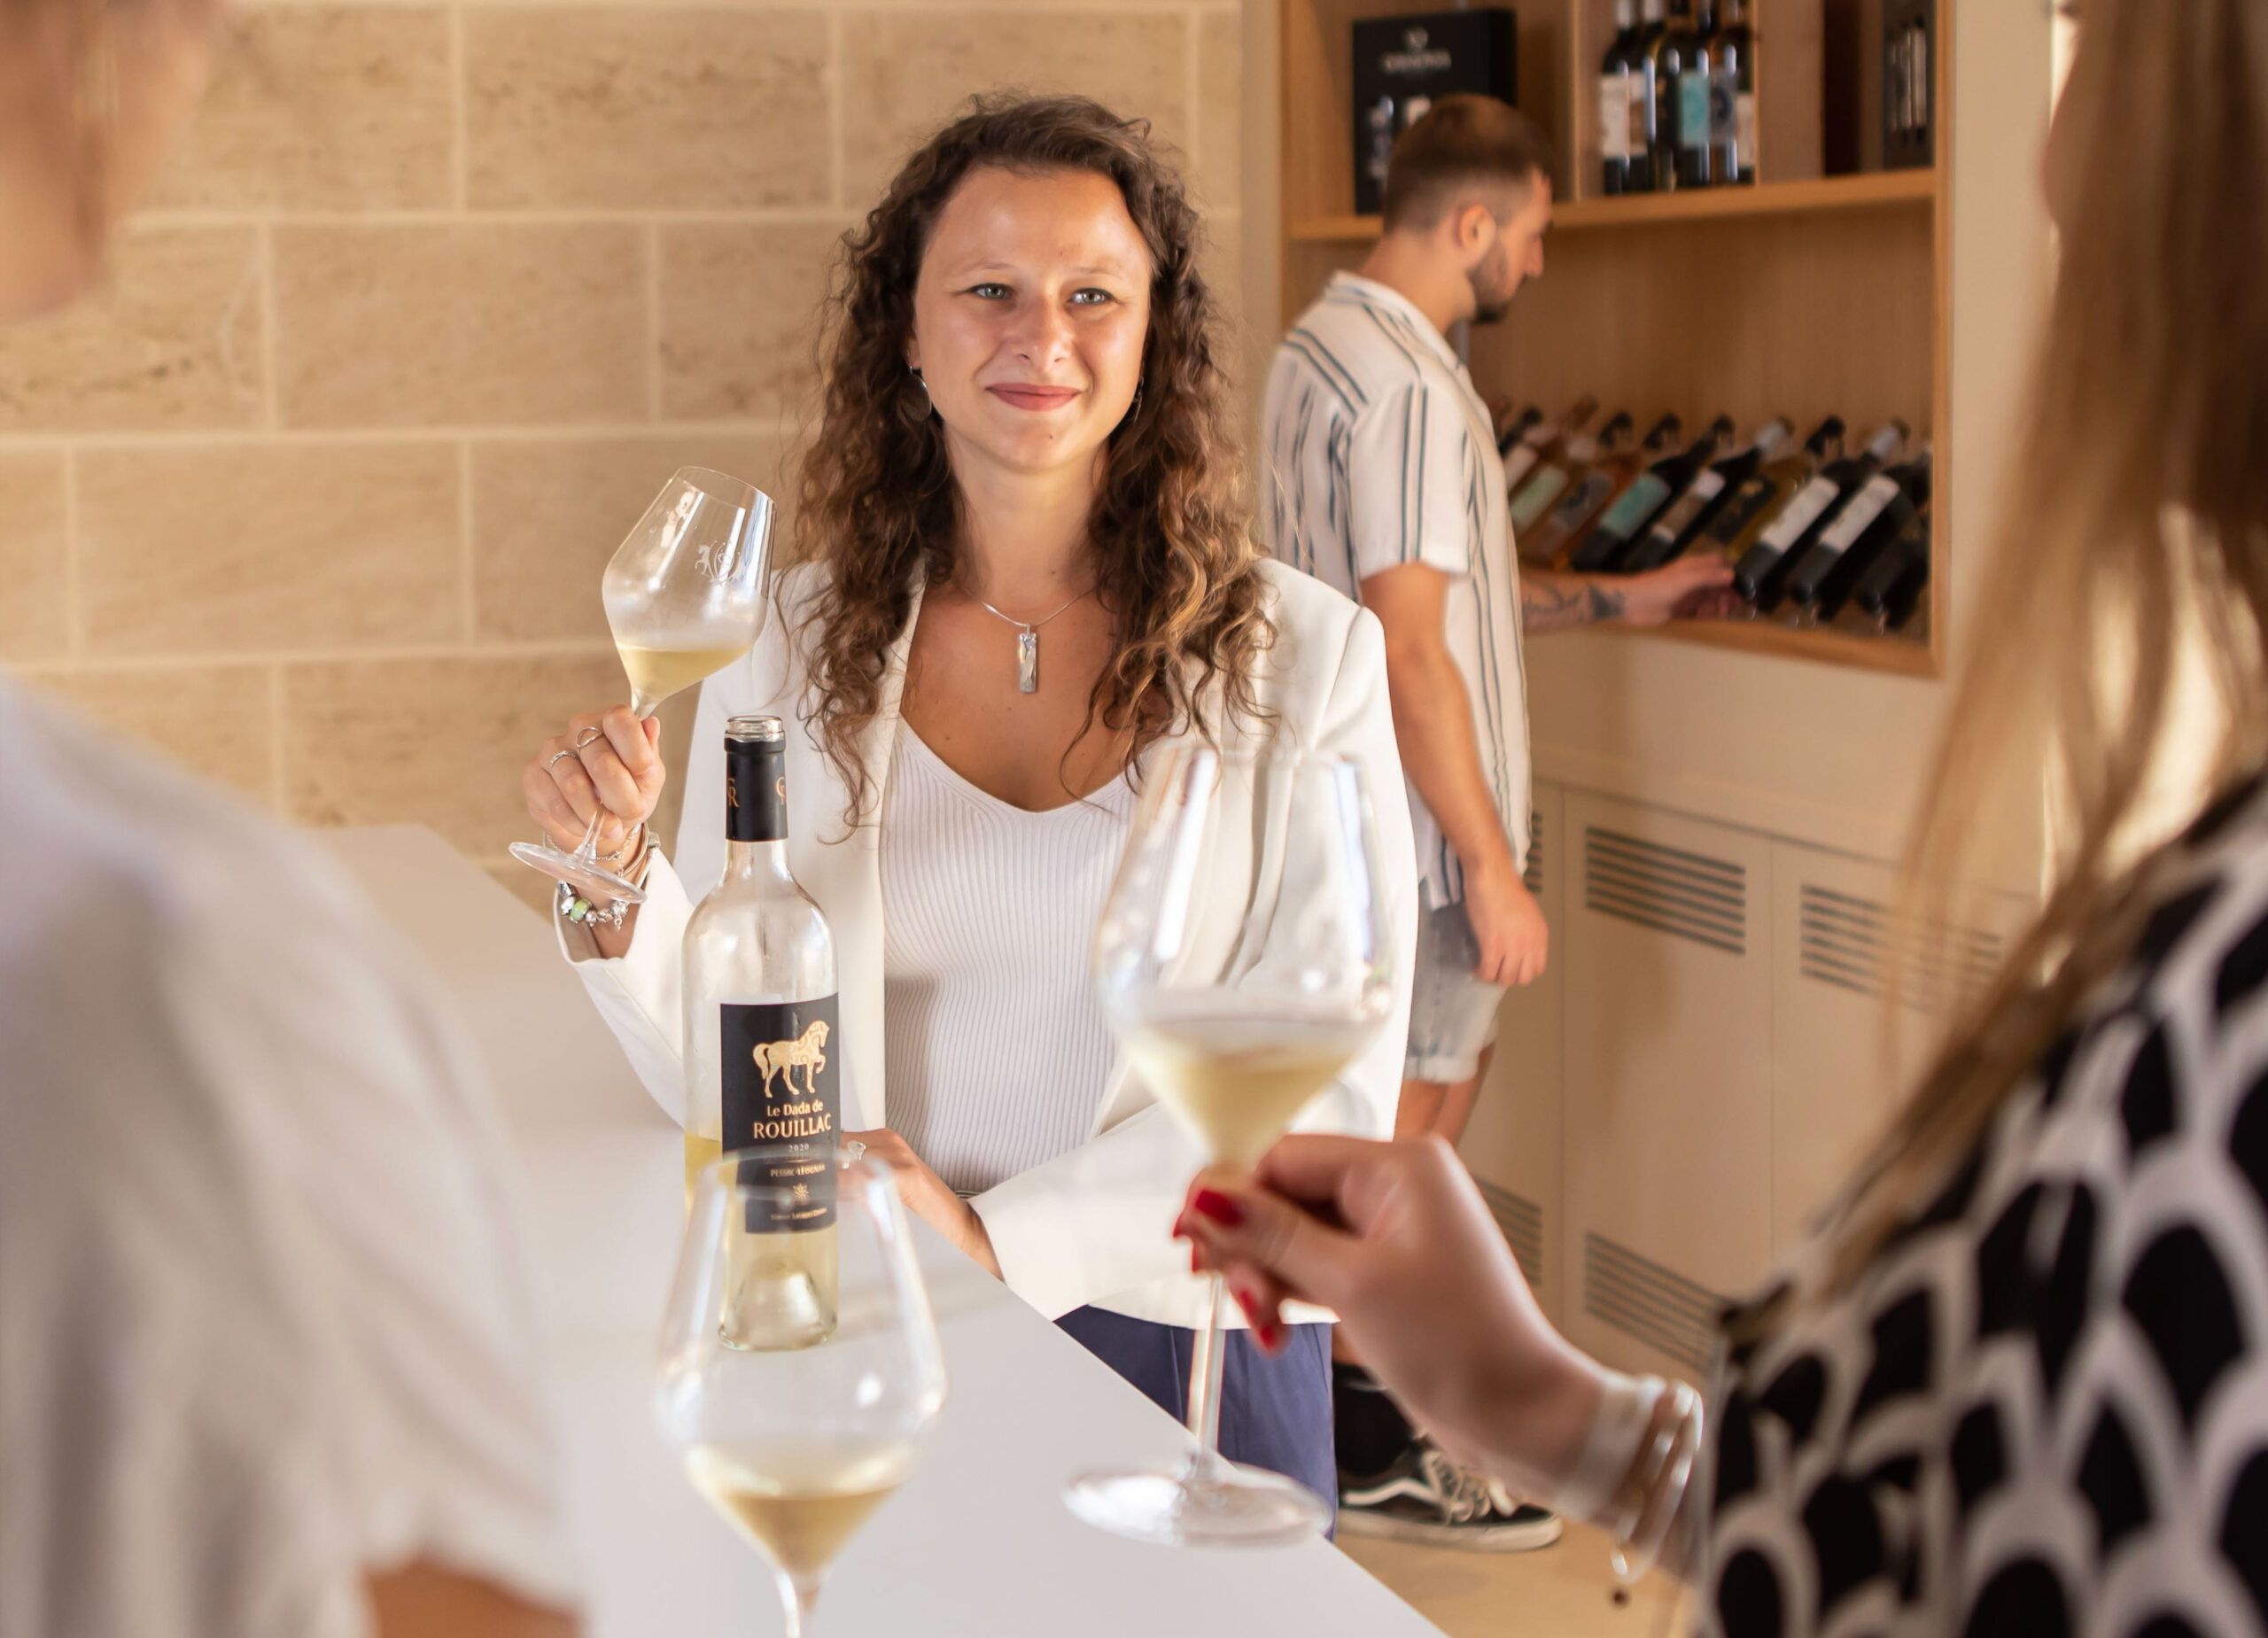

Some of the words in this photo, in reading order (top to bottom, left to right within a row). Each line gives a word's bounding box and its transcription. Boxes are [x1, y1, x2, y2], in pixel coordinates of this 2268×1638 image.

[767, 1105, 781, 1117] Le
[784, 1100, 811, 1116] Dada
[812, 1098, 824, 1113] de
[753, 1112, 832, 1139] ROUILLAC
[788, 1142, 810, 1153] 2020
